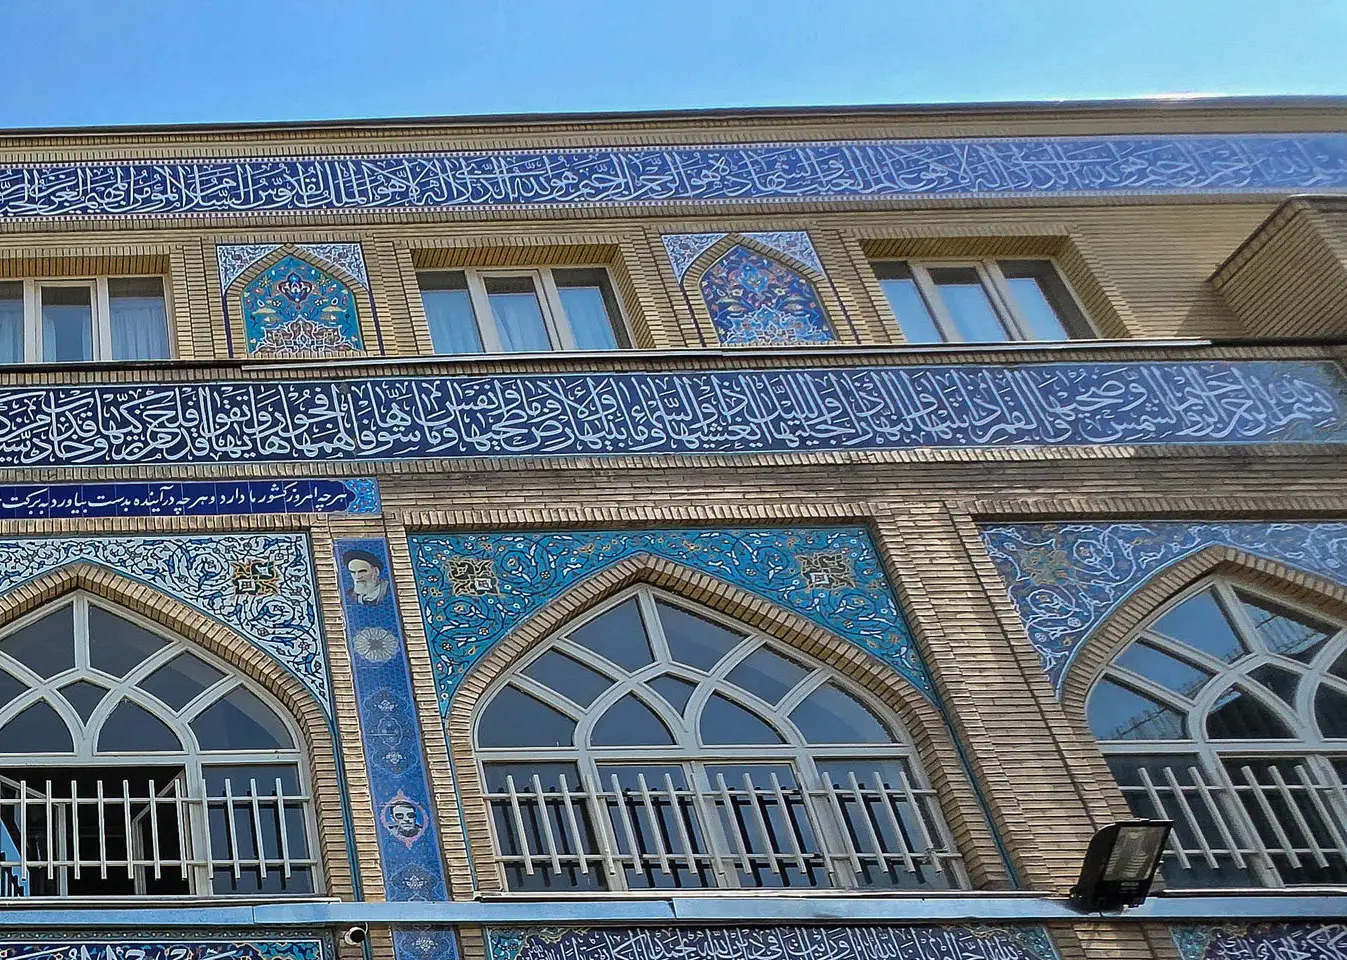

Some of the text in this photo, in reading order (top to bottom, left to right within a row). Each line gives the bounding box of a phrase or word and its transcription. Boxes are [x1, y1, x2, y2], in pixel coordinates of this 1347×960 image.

[2, 487, 48, 515] برکت
[133, 485, 174, 512] آینده
[162, 496, 174, 506] در
[219, 487, 245, 504] دارد
[249, 490, 256, 503] ما
[258, 481, 297, 503] کشور
[287, 486, 317, 507] امروز
[315, 492, 348, 511] هرچه
[50, 492, 87, 514] بیاورد
